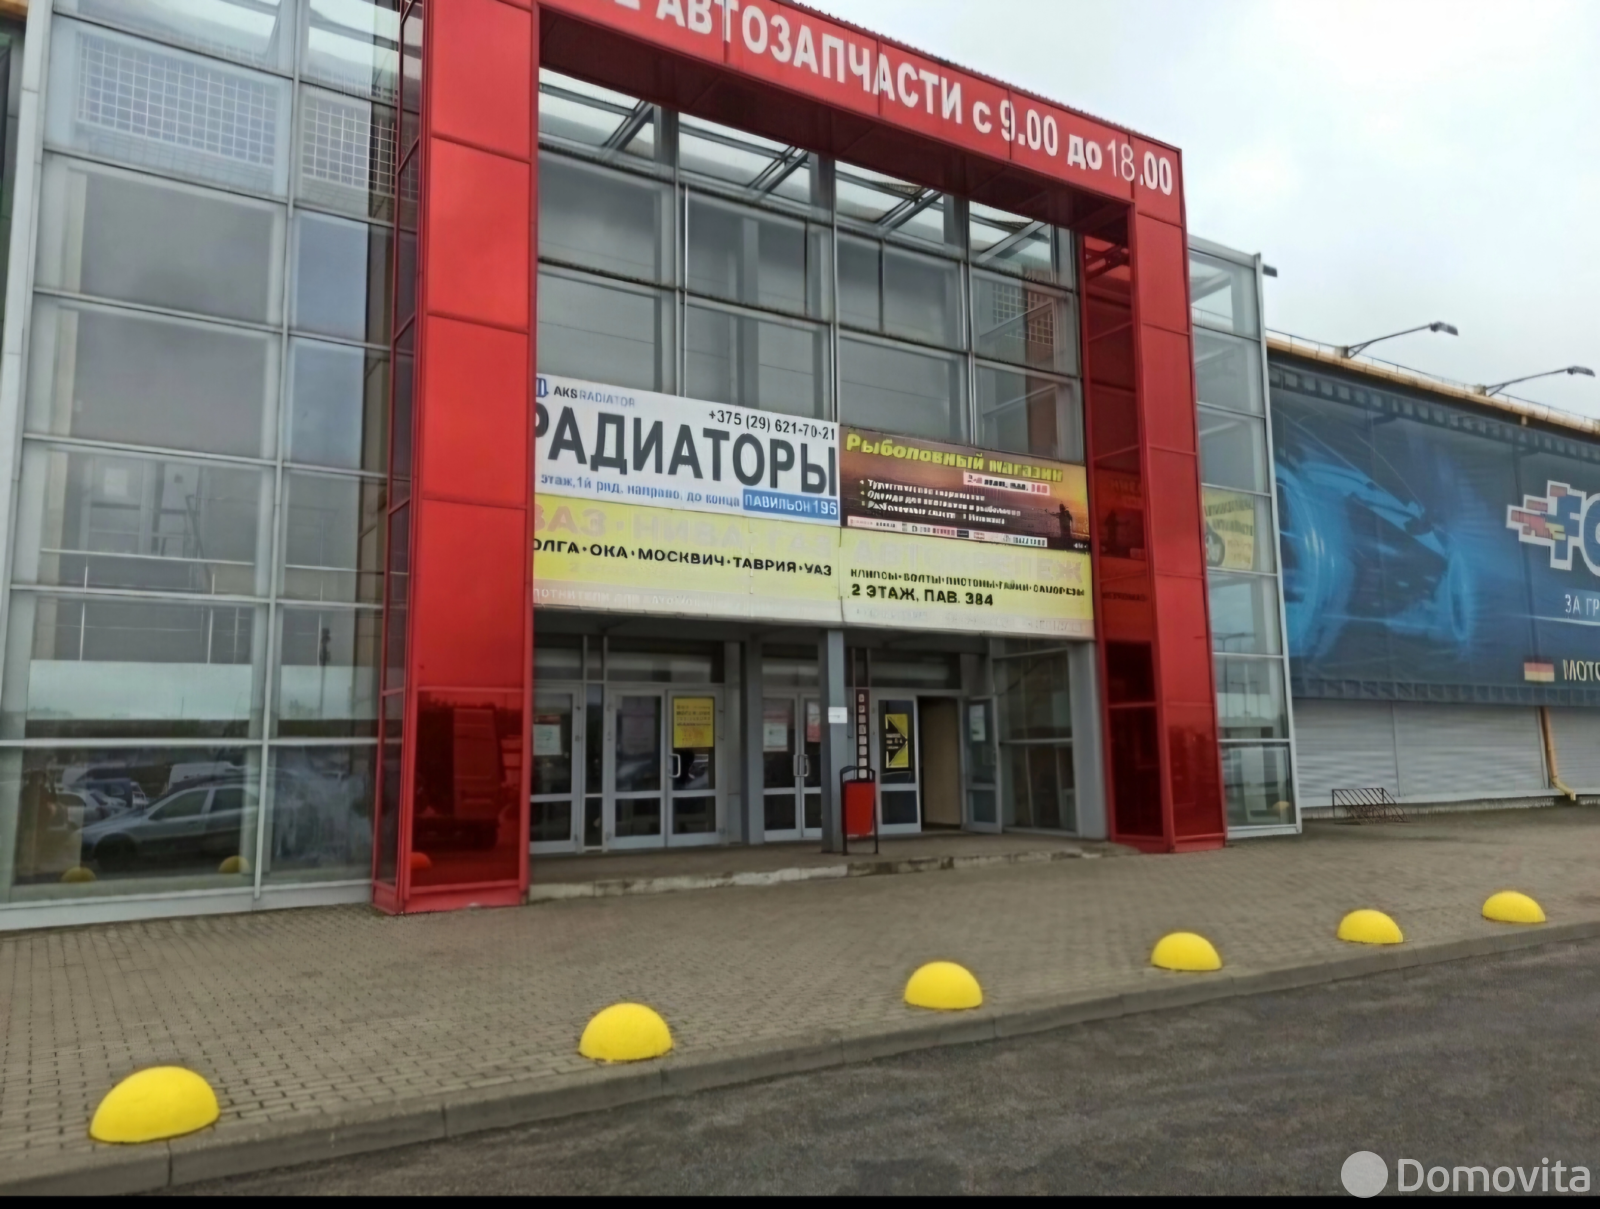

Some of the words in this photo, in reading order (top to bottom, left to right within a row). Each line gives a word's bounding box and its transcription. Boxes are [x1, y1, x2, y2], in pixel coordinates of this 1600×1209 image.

[655, 0, 963, 124] АВТОЗАПЧАСТИ
[972, 100, 993, 134] с
[999, 99, 1059, 157] 9.00
[1066, 135, 1104, 171] до
[1105, 138, 1173, 196] 18.00
[708, 409, 742, 426] +375
[745, 414, 771, 433] (29)
[774, 419, 836, 440] 621-70-21
[846, 433, 984, 471] Рыболовный
[744, 493, 811, 514] ПАВИЛЬОН
[812, 499, 838, 516] 196
[589, 543, 628, 559] ОКА
[637, 548, 726, 567] МОСКВИЧ
[732, 556, 797, 574] ТАВРИЯ
[803, 562, 832, 577] УАЗ
[851, 584, 861, 596] 2
[866, 585, 920, 602] ЭТАЖ,
[924, 590, 961, 604] ПАВ.
[965, 592, 994, 607] 384
[1564, 593, 1581, 615] ЗА
